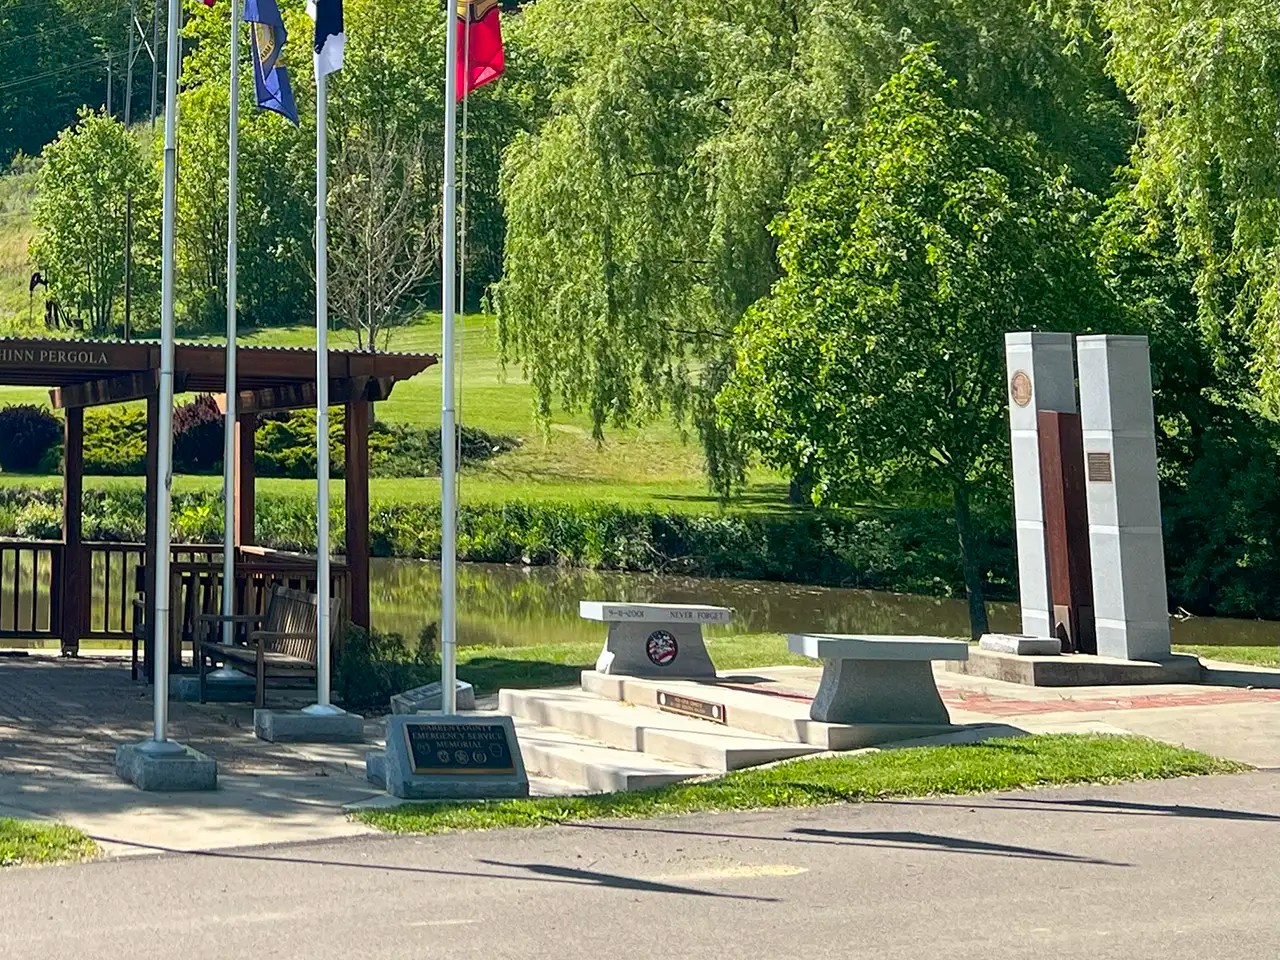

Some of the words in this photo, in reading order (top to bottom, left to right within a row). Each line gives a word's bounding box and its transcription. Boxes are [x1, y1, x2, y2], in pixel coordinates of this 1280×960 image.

[40, 349, 108, 364] PERGOLA
[670, 611, 693, 619] NEVER
[697, 612, 723, 620] FORGET
[412, 732, 465, 740] EMERGENCY
